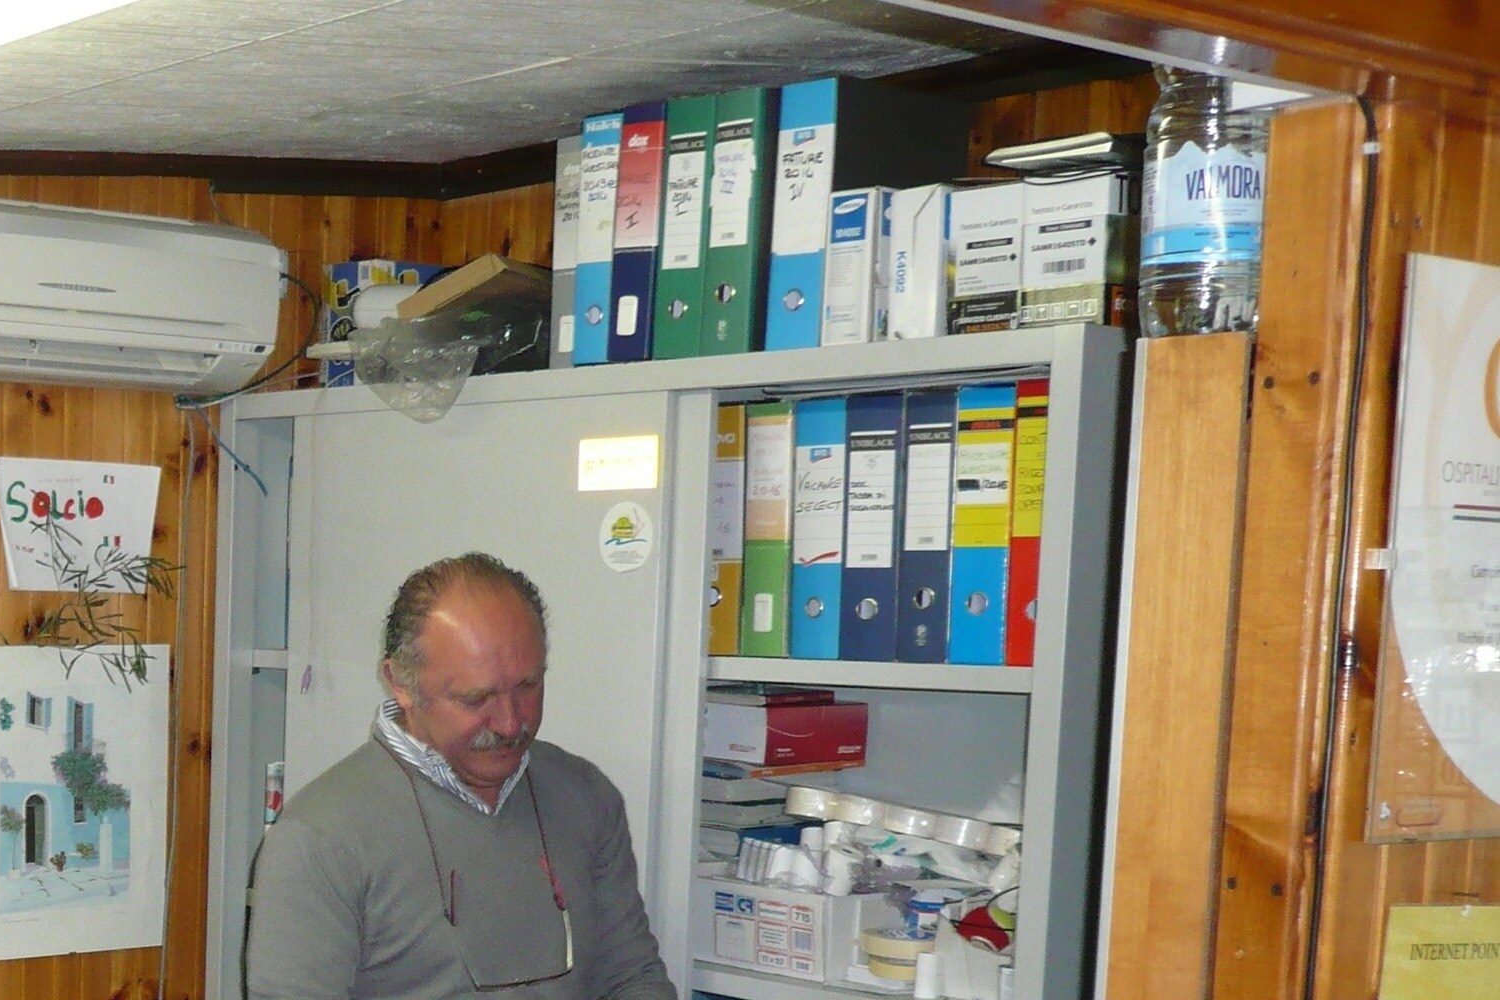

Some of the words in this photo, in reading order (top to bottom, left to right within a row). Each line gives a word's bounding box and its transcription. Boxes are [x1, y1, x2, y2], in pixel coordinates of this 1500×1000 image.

[627, 133, 650, 148] dox
[1186, 164, 1261, 201] VALMORA
[1410, 943, 1469, 961] INTERNET
[1471, 942, 1500, 960] POIN
